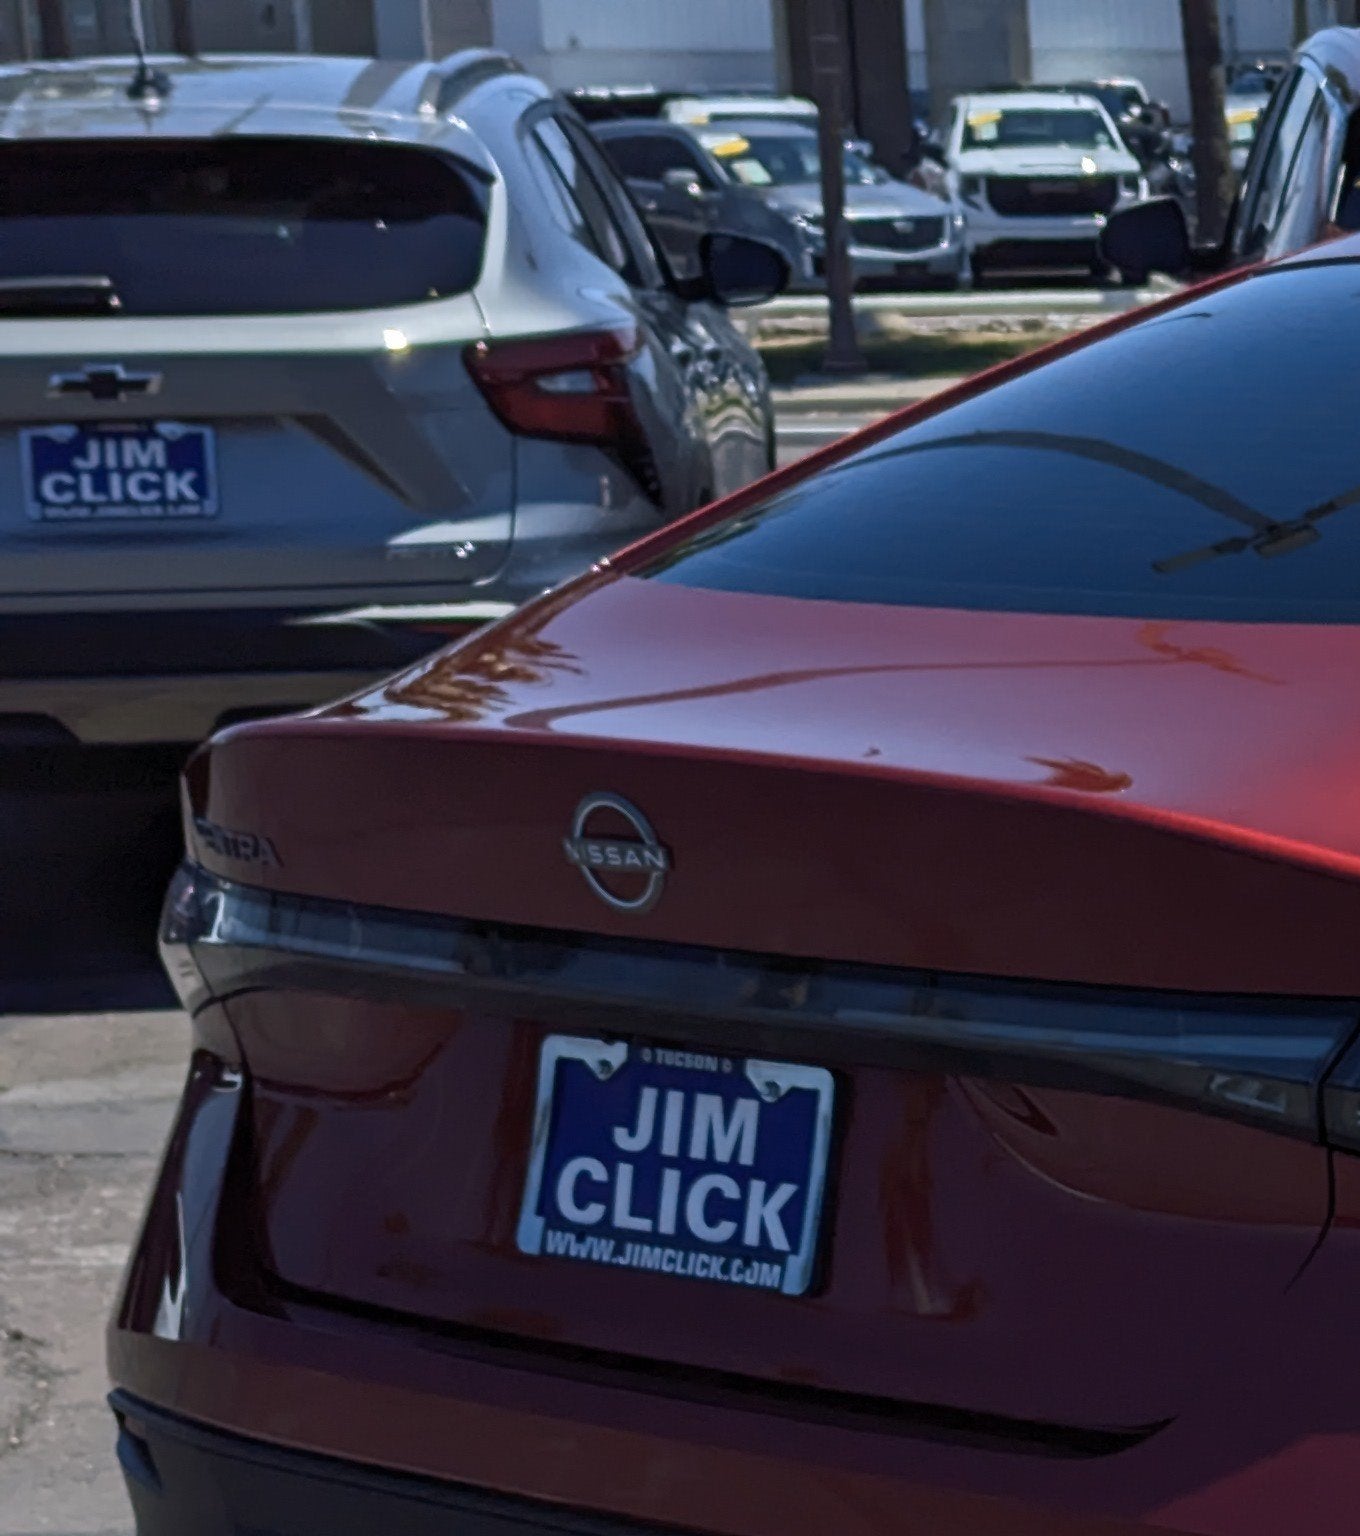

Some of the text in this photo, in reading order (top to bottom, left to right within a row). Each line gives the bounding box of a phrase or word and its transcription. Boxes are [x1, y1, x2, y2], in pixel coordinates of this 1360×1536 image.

[73, 438, 166, 469] JIM
[40, 470, 200, 503] CLICK
[563, 837, 667, 870] NISSAN
[655, 1048, 719, 1072] TUCSON
[613, 1087, 760, 1165] JIM
[556, 1157, 798, 1251] CLICK
[546, 1230, 782, 1287] WWW.JIMCLICK.COM
